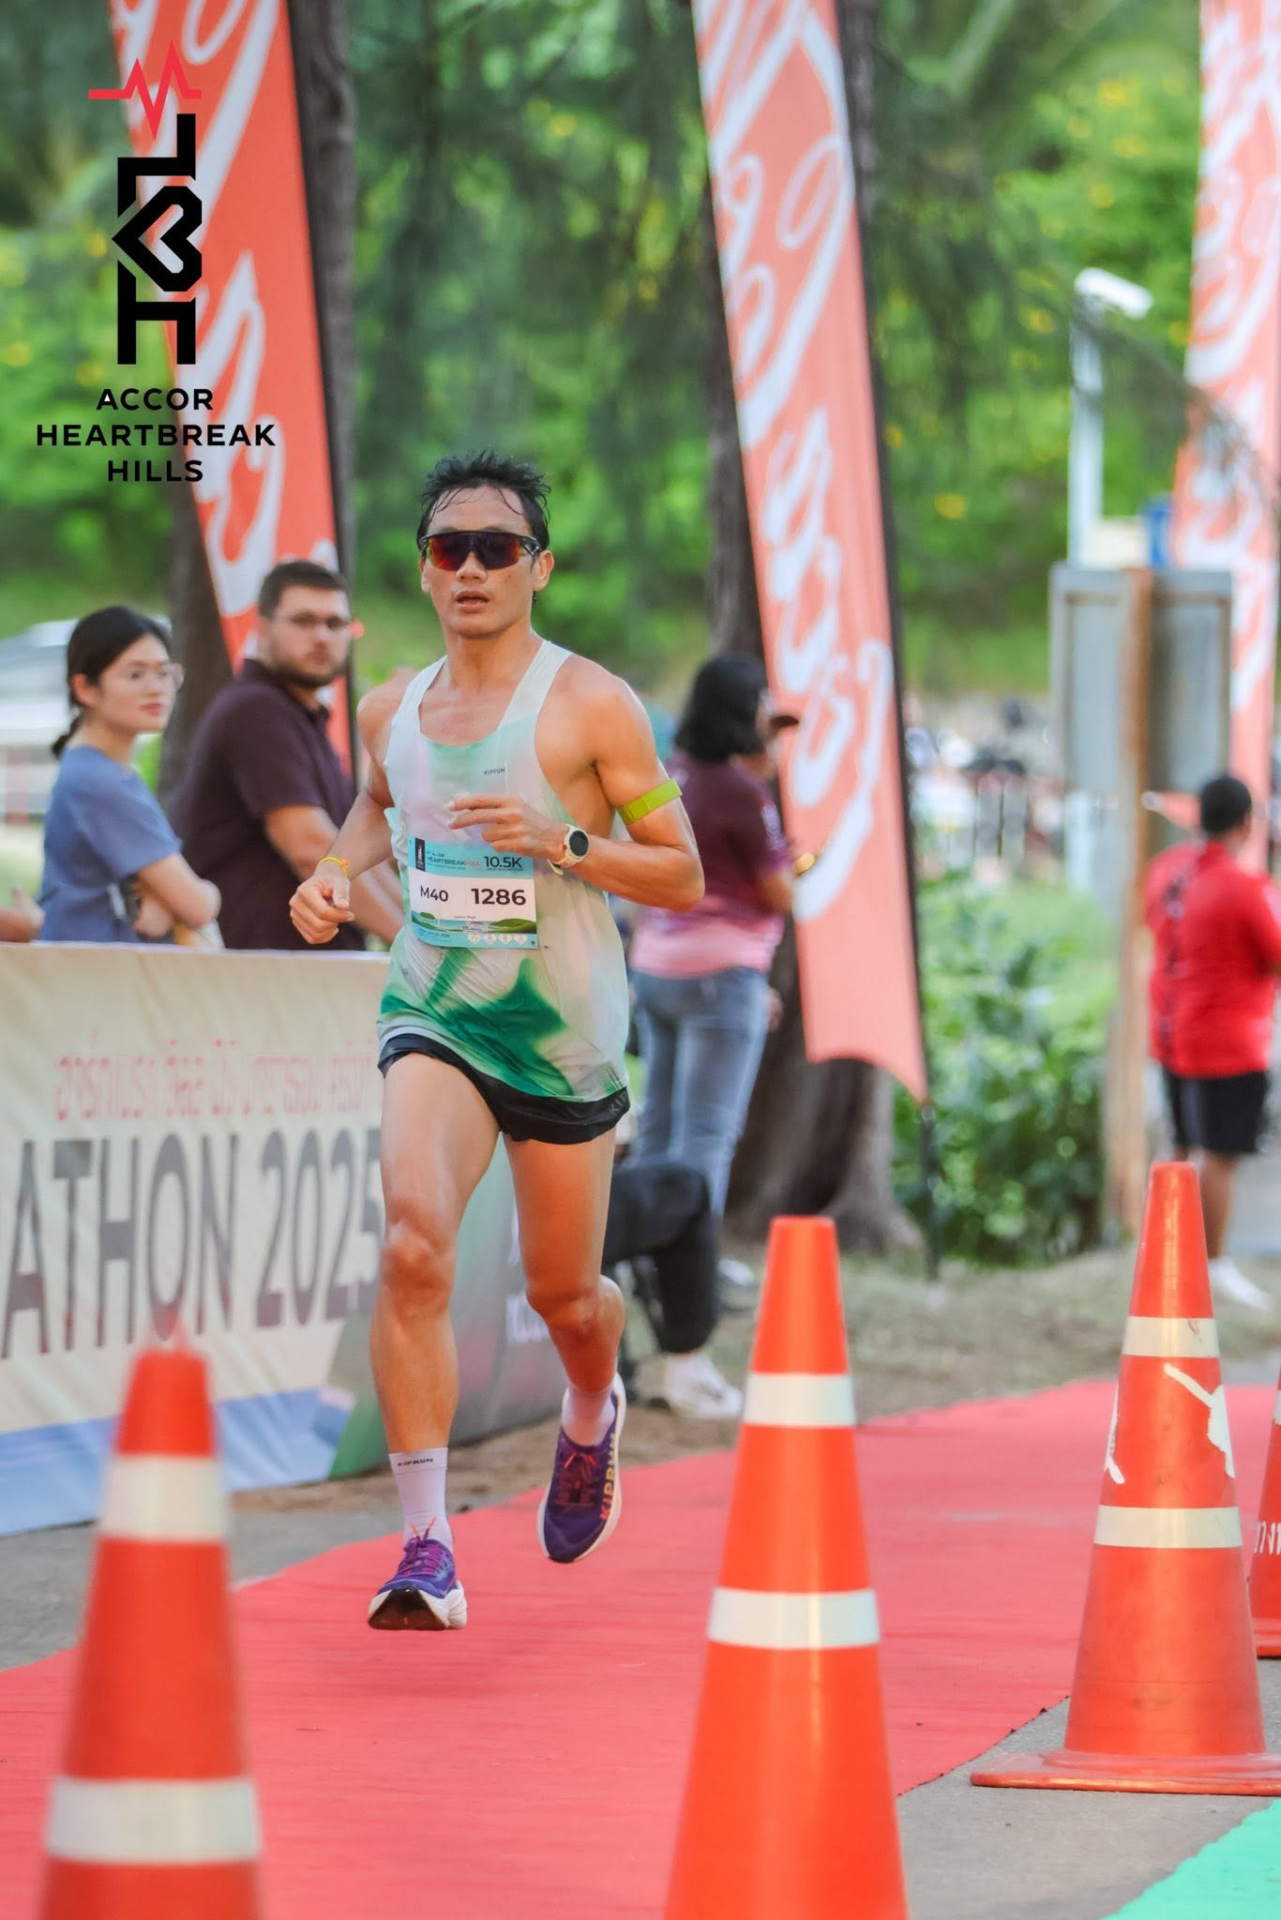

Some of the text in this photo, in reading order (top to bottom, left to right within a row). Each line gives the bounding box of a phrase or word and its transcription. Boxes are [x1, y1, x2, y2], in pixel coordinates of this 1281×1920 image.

[484, 856, 523, 868] 10.5K
[420, 885, 527, 906] M40 1286
[0, 1128, 382, 1360] ATHON 2025
